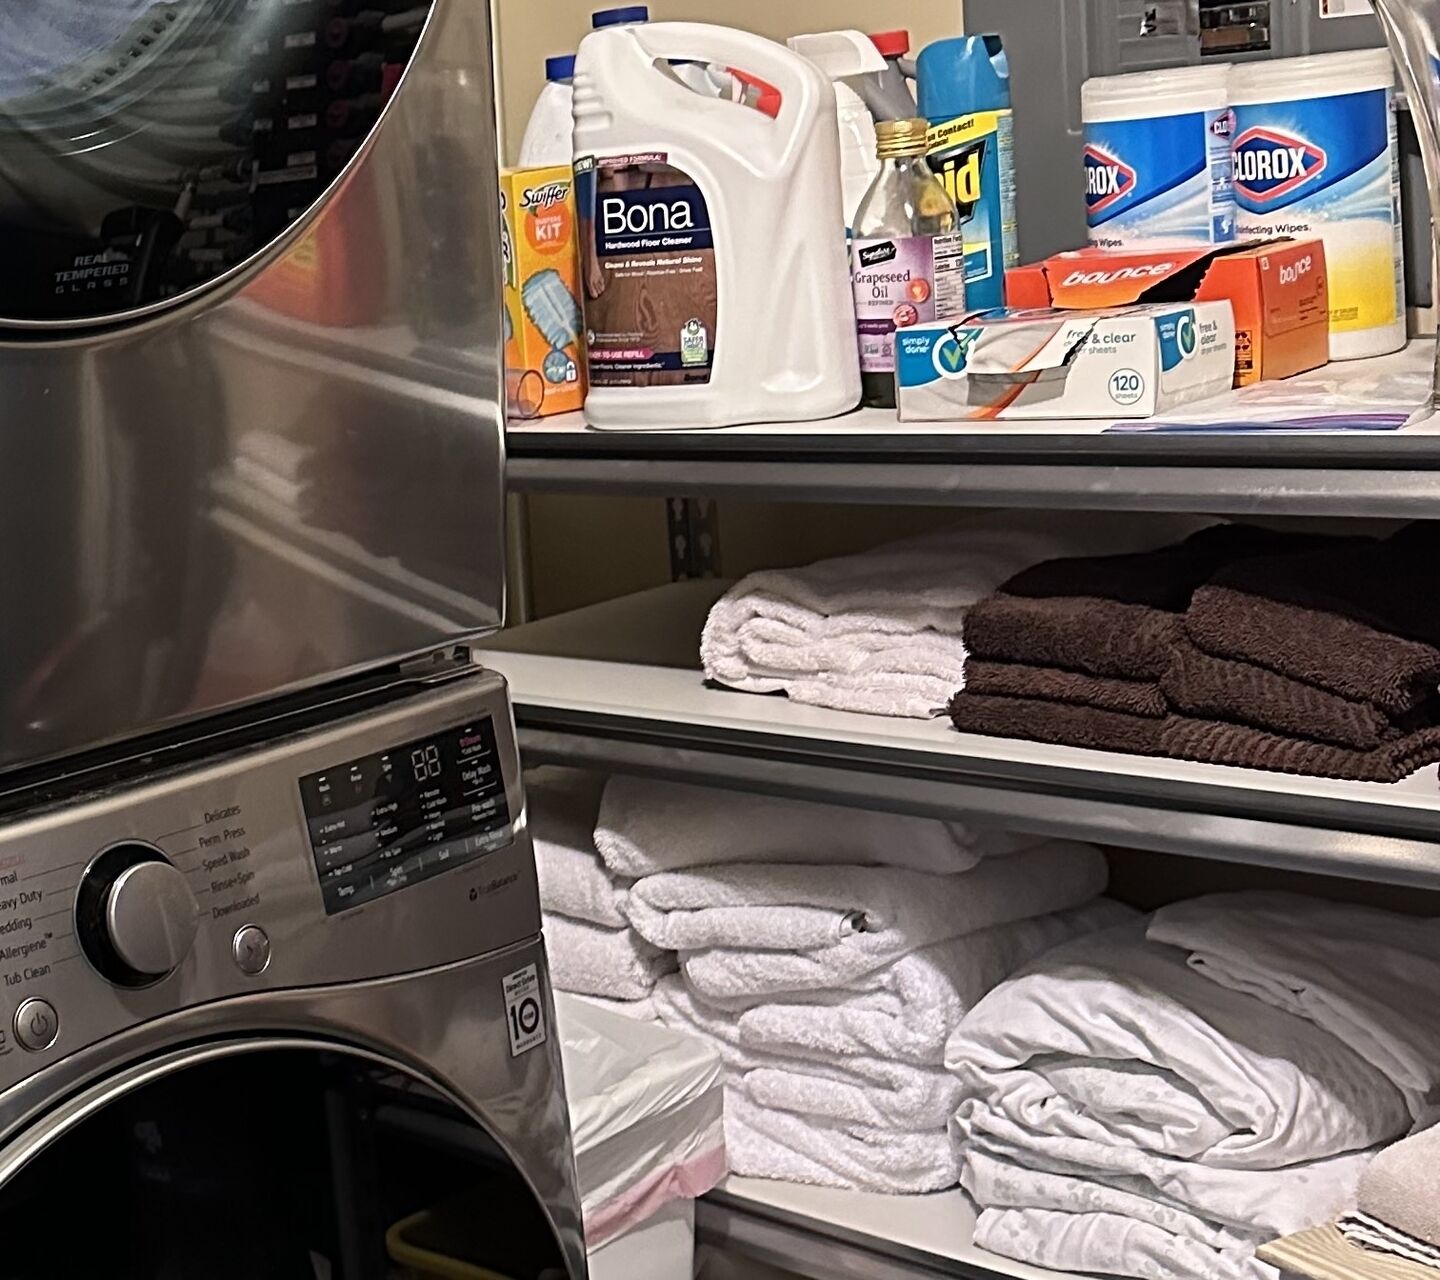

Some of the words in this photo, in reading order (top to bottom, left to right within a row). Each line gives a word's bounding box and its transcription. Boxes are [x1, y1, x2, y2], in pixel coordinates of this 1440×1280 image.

[937, 119, 974, 138] Contact!
[1231, 147, 1308, 181] CLOROX
[934, 149, 981, 203] id
[519, 185, 569, 208] Swiffer
[603, 198, 695, 234] Bona
[535, 223, 562, 241] KIT
[605, 240, 640, 250] Hardwood
[641, 239, 660, 248] Floor
[661, 237, 693, 246] Cleaner
[855, 270, 910, 286] Grapeseed
[1062, 263, 1173, 287] bounce
[1279, 255, 1312, 284] bounce
[872, 286, 888, 298] Oil
[902, 337, 930, 346] simply
[1092, 333, 1101, 344] &
[1103, 332, 1137, 344] clear
[905, 345, 929, 354] done
[1112, 375, 1139, 391] 120
[204, 805, 241, 824] Delicates
[223, 827, 246, 840] Press
[202, 854, 228, 872] Speed
[19, 890, 42, 904] Duty
[212, 892, 260, 919] Downloaded
[4, 973, 22, 986] Tub
[24, 964, 51, 980] Clean
[511, 997, 540, 1041] 10
